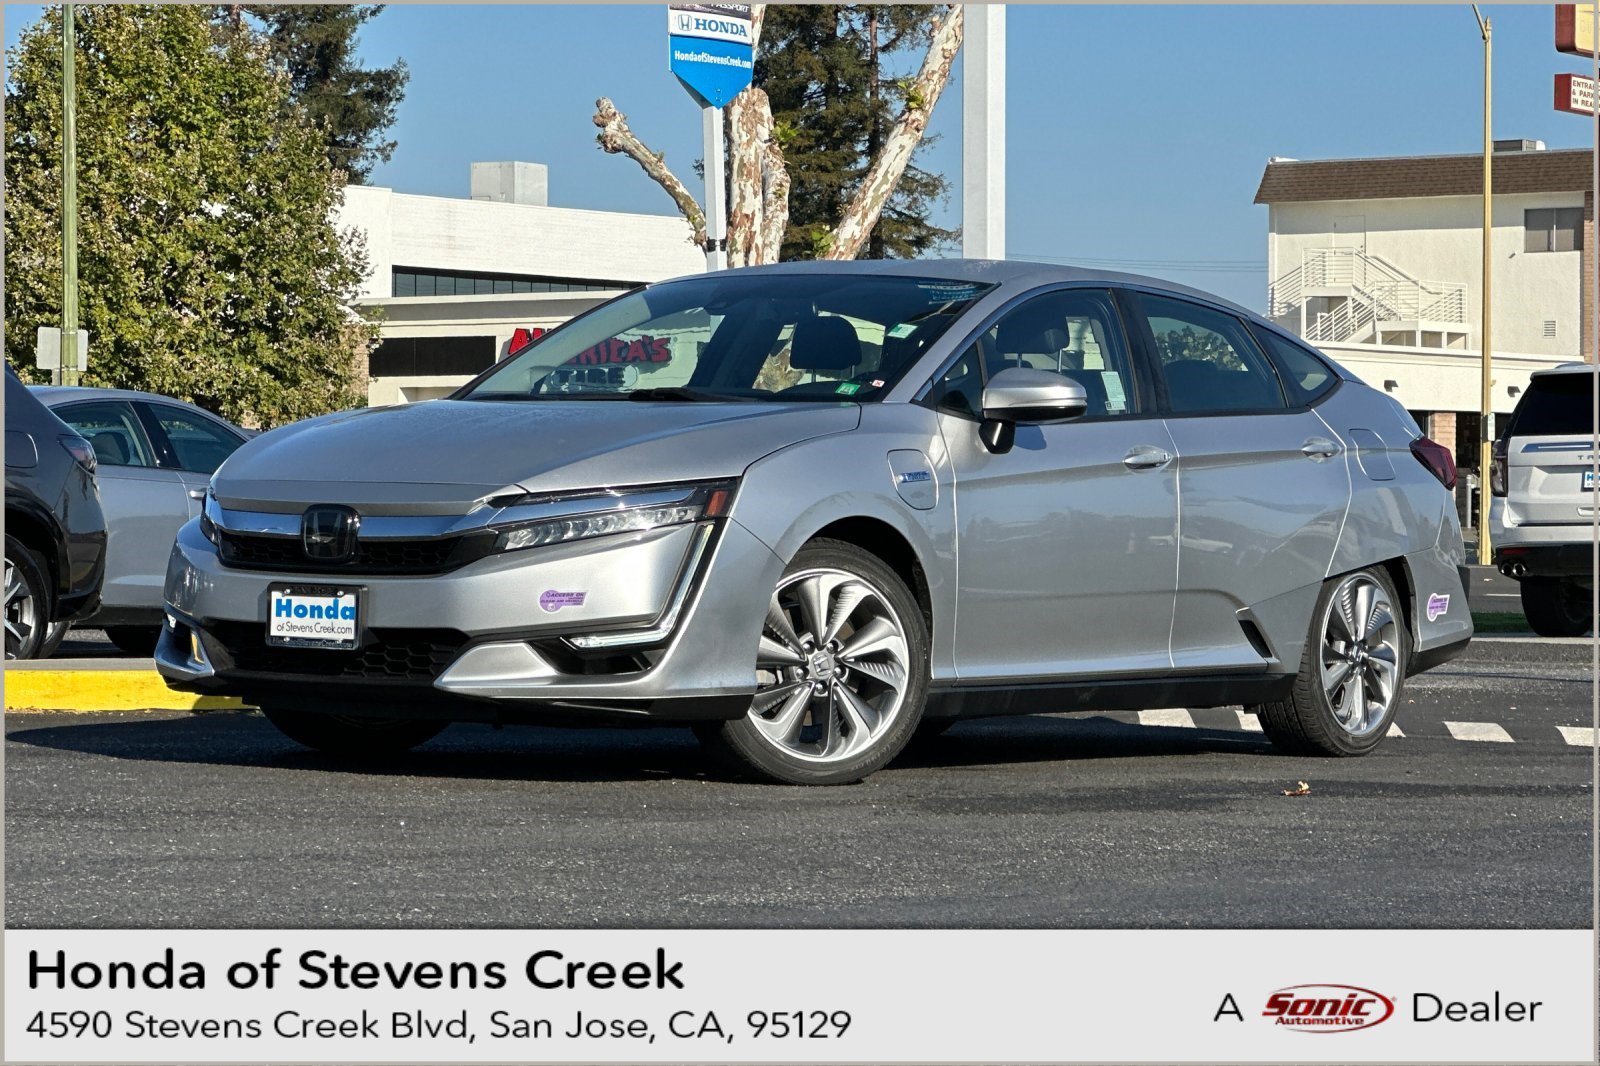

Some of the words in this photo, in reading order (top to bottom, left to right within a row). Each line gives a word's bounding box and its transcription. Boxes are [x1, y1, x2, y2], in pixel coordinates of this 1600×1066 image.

[694, 18, 748, 37] HONDA
[674, 50, 752, 69] HondaofStevensCreek.com
[555, 368, 626, 385] TIRE
[275, 597, 356, 620] Honda
[276, 623, 285, 632] of
[285, 621, 314, 633] Stevens
[314, 622, 353, 635] Creek.com
